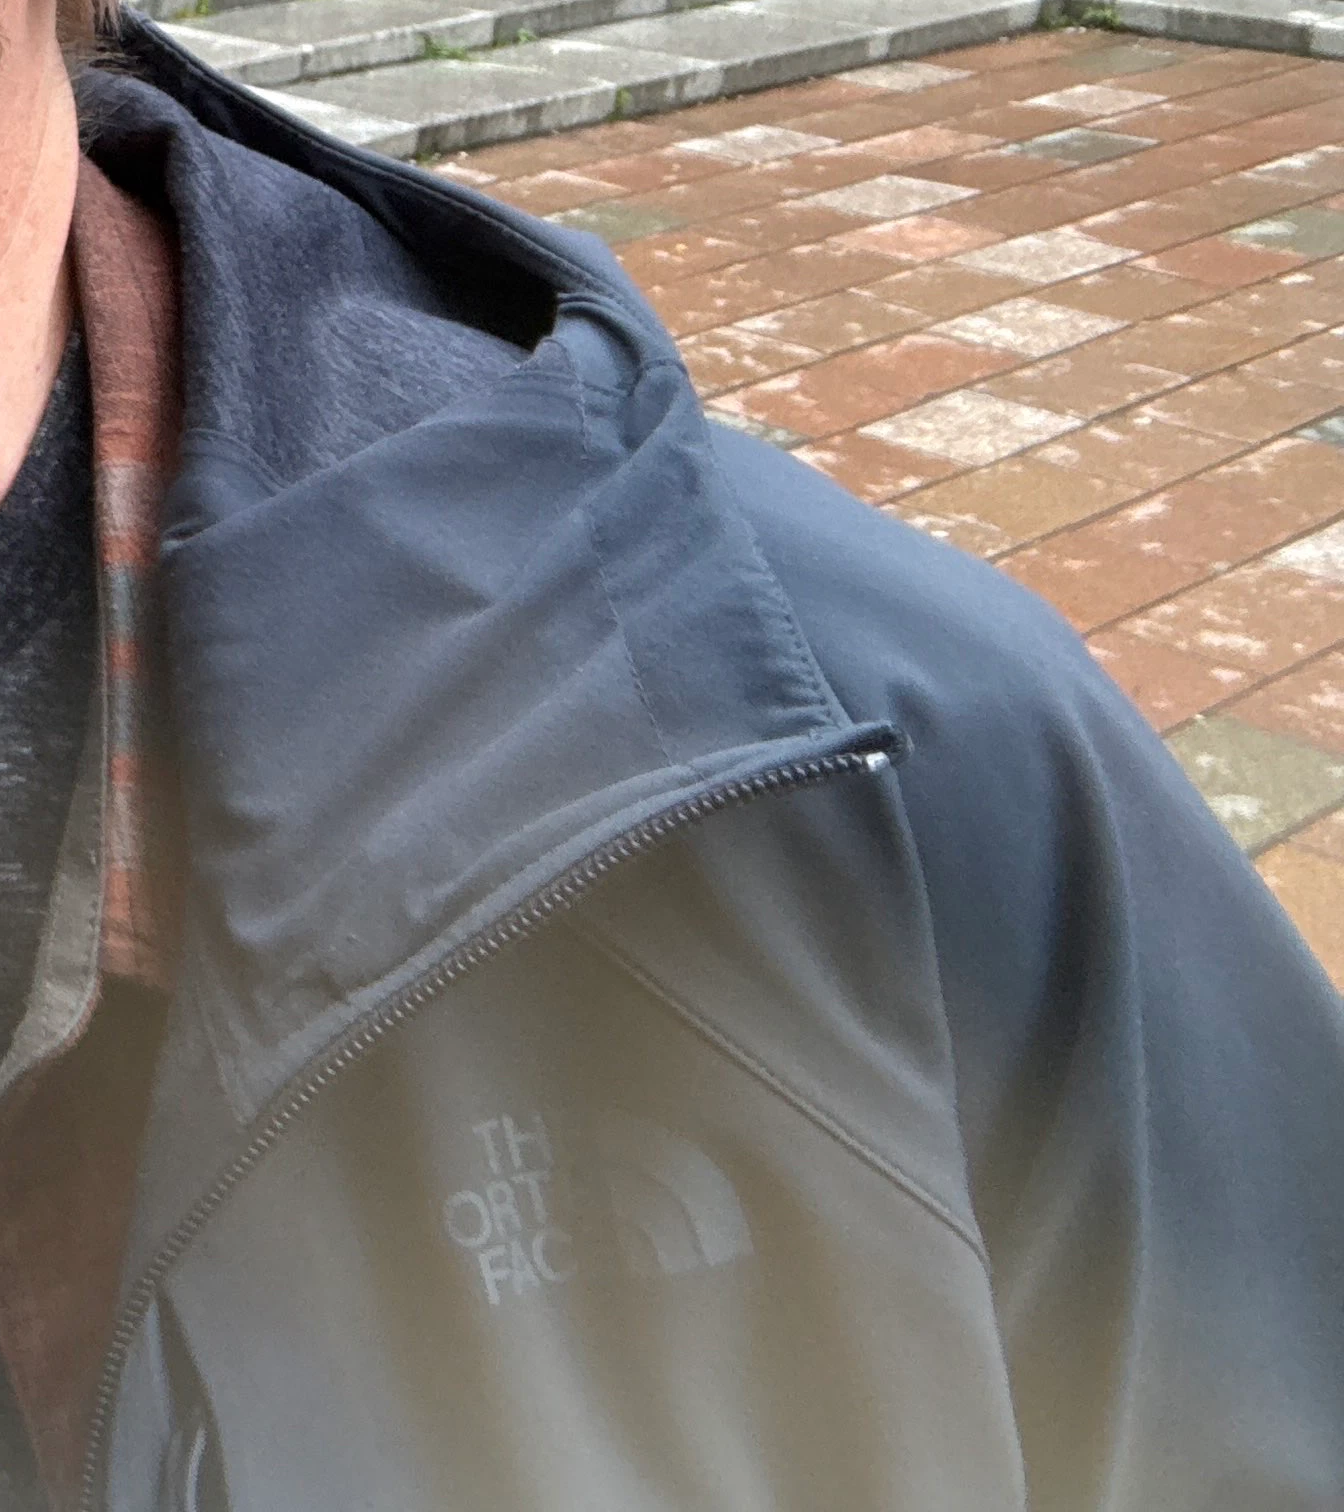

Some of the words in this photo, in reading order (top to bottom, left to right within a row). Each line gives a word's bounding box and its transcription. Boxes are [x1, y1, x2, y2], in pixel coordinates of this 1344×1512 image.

[472, 1111, 555, 1176] TH
[443, 1170, 552, 1249] ORT
[477, 1225, 579, 1306] FAC
